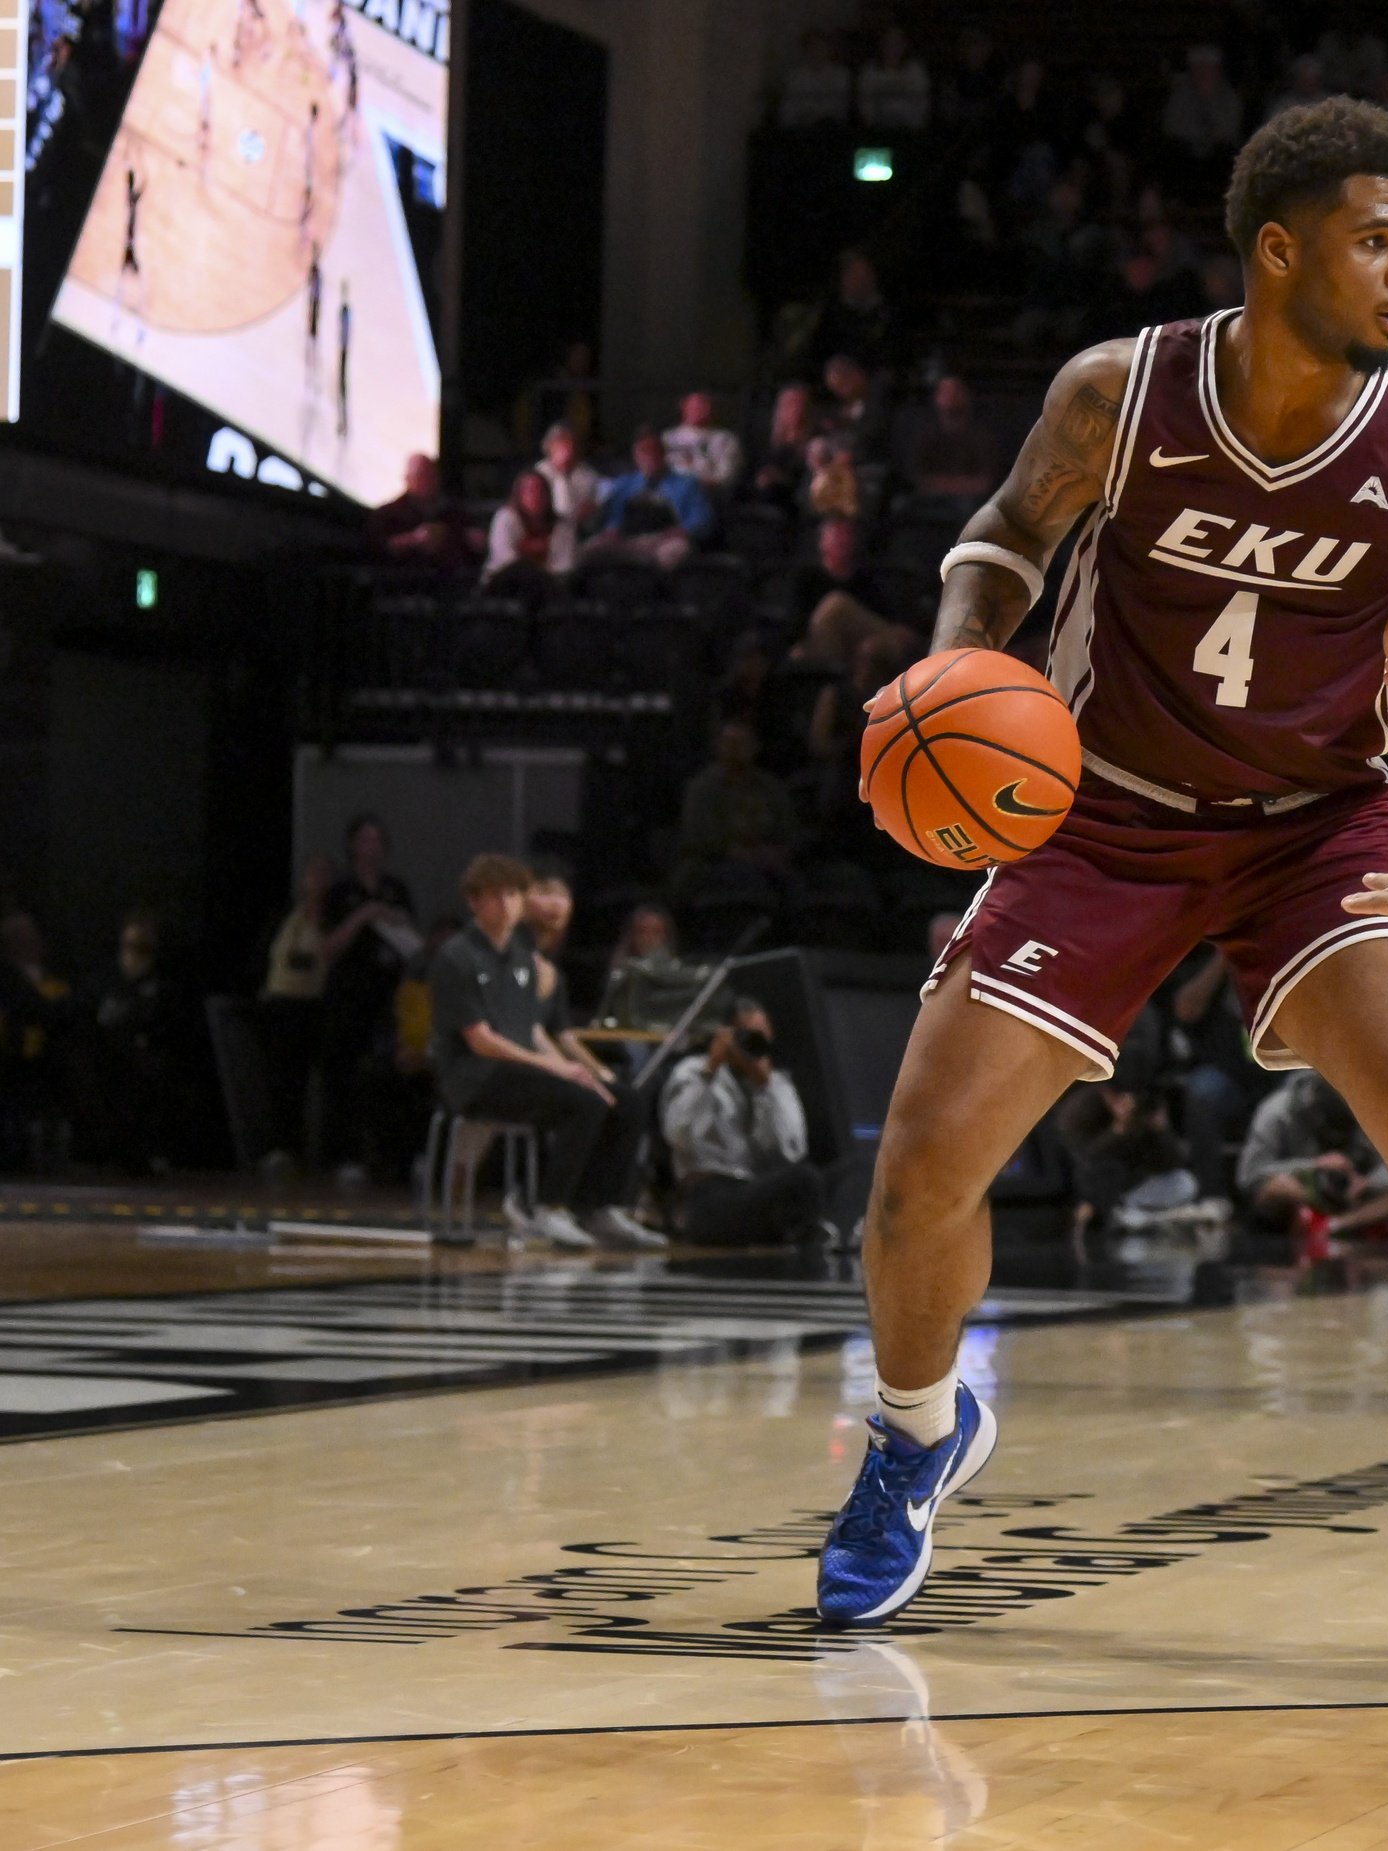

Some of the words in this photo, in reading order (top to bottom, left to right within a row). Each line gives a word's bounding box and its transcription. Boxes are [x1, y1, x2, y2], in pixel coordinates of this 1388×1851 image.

[1154, 507, 1372, 584] EKU
[1192, 590, 1260, 709] 4
[108, 1566, 758, 1645] Ingram
